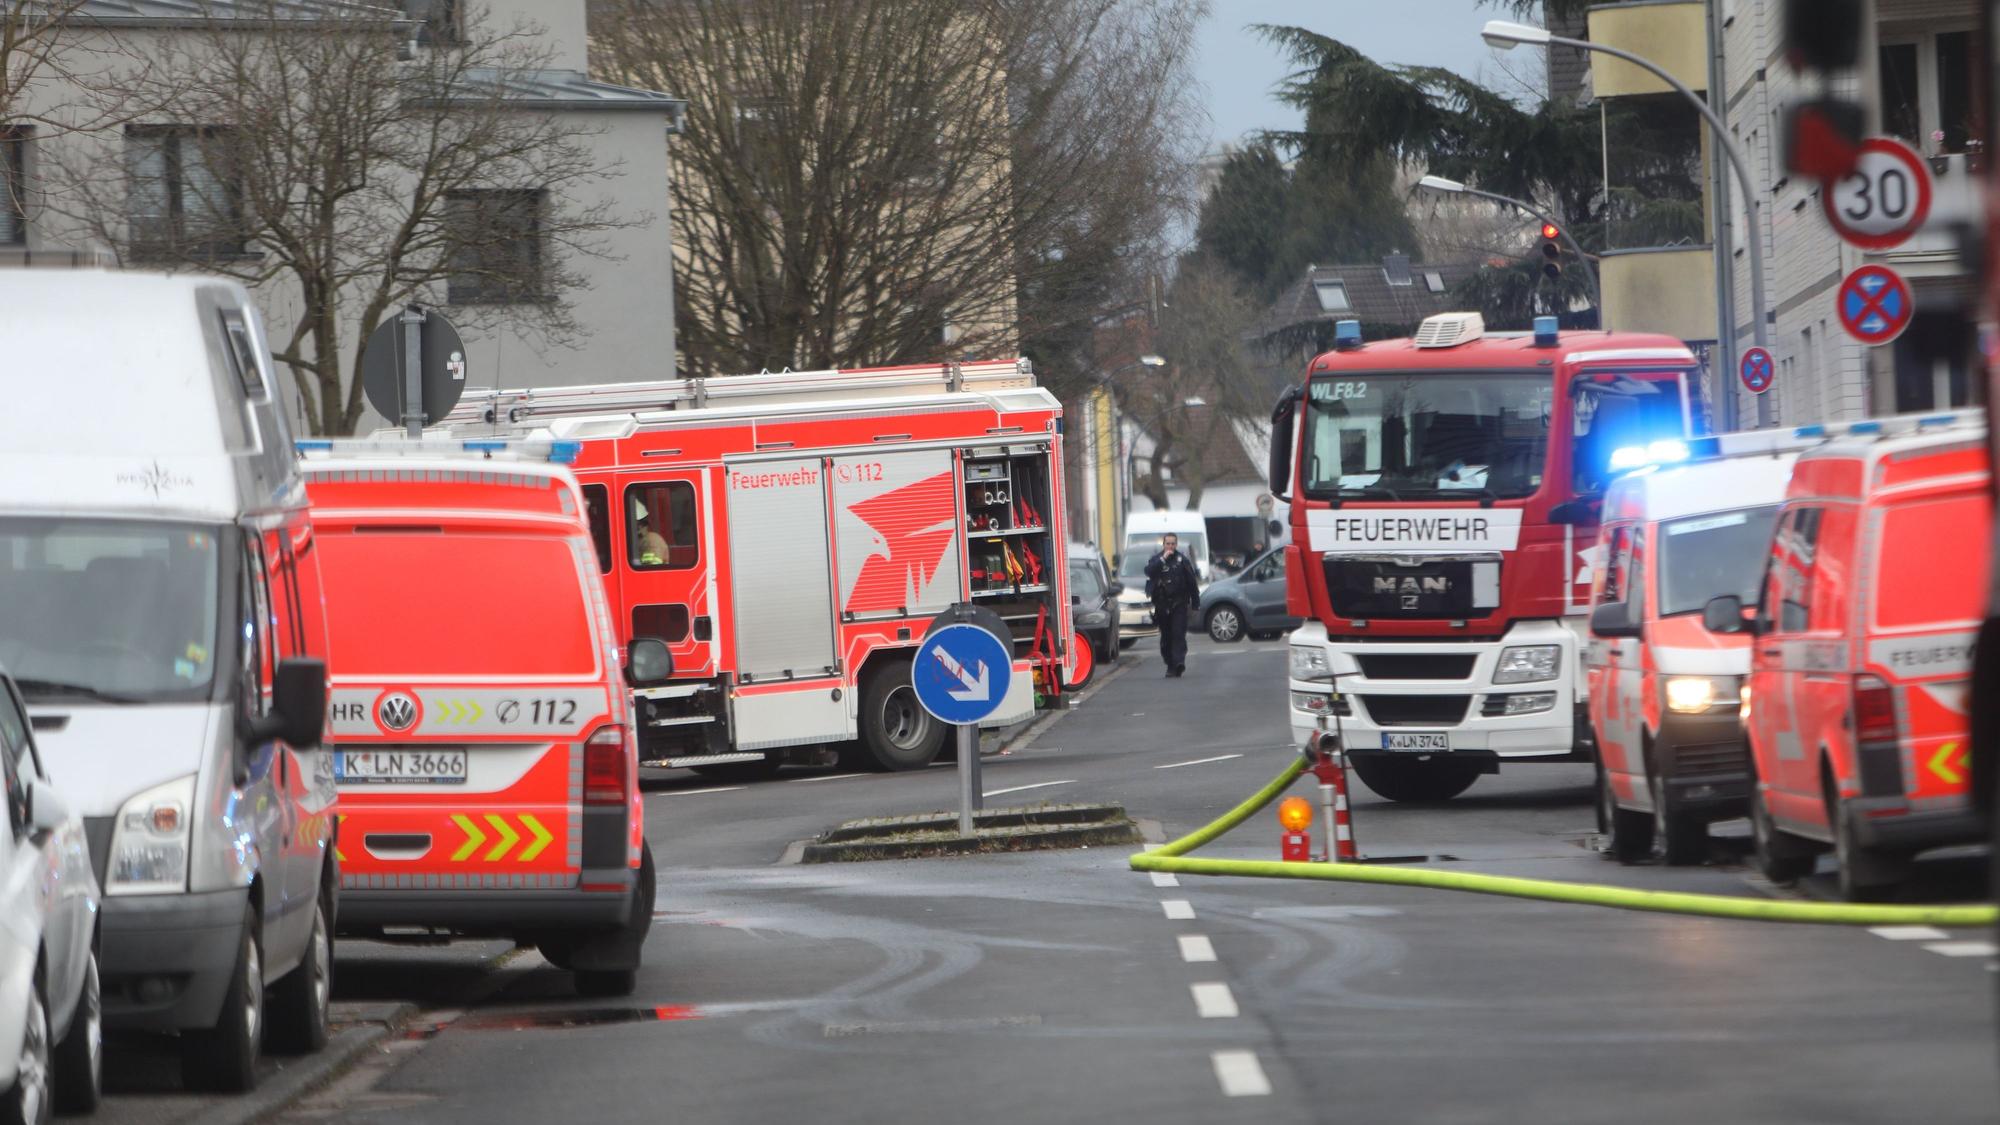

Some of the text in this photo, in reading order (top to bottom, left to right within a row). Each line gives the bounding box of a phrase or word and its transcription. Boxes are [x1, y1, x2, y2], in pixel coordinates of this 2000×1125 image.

[1845, 169, 1908, 221] 30
[1311, 382, 1367, 400] WLF8.2
[731, 466, 818, 490] Feuerwehr
[854, 463, 883, 482] 112
[1335, 518, 1489, 541] FEUERWEHR
[1373, 577, 1447, 594] MAN
[530, 698, 578, 725] 112
[409, 754, 464, 775] 3666
